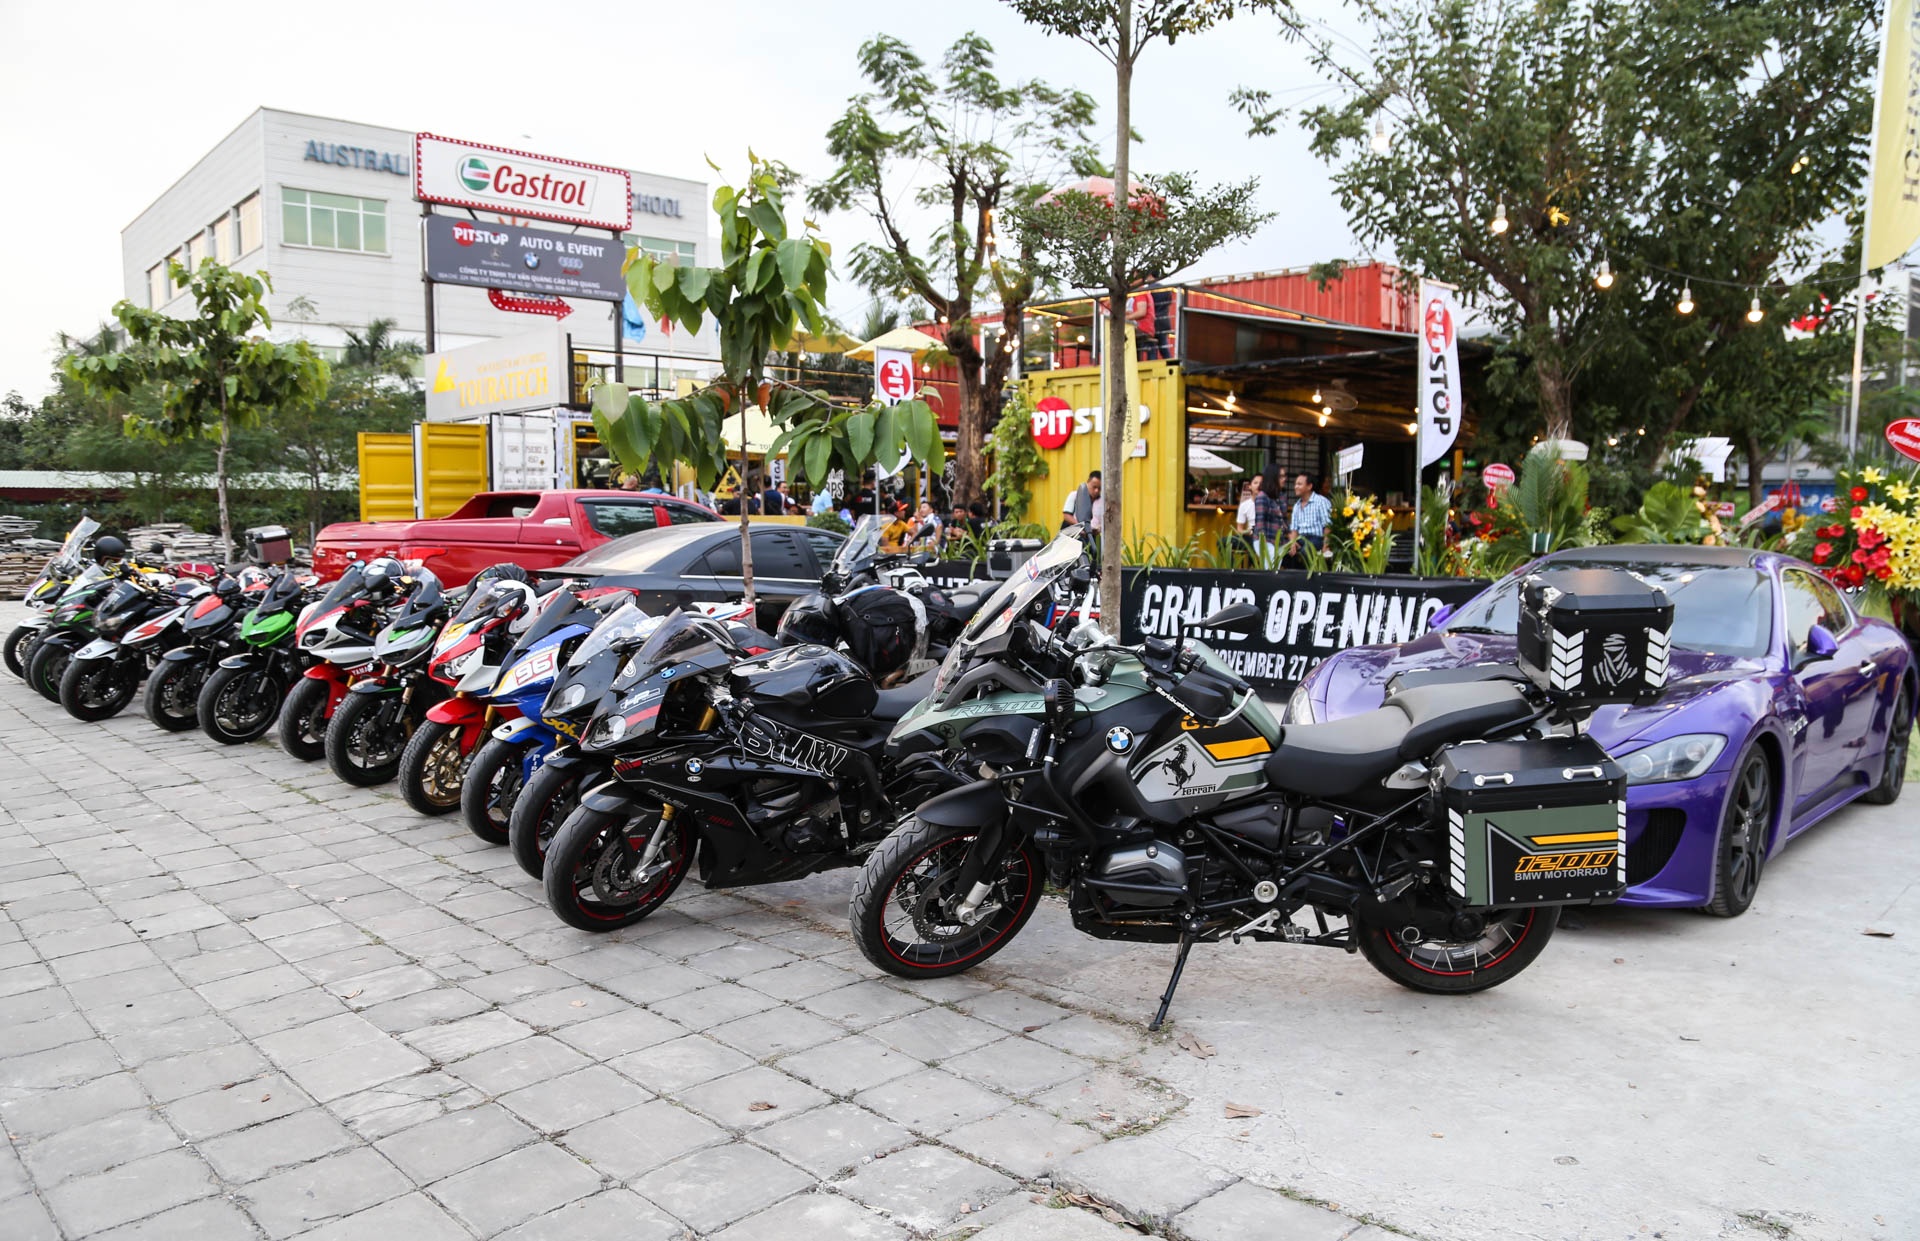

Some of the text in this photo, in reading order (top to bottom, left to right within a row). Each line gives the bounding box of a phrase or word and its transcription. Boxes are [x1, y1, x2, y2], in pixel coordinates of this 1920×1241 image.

[303, 139, 410, 175] AUSTRALI
[494, 165, 586, 206] Castrol
[631, 192, 683, 218] CHOOL
[453, 226, 605, 257] PITSTOP AUTO & EVENT
[459, 365, 548, 408] TOURATECH
[1031, 404, 1150, 437] PITST
[1290, 655, 1308, 682] 27
[951, 700, 1045, 718] R1200
[1155, 686, 1195, 717] Barkbusters
[734, 716, 848, 777] BMW
[1182, 784, 1217, 796] Ferrari
[1515, 850, 1618, 873] 1200
[1515, 867, 1608, 881] BMW MOTORRAD
